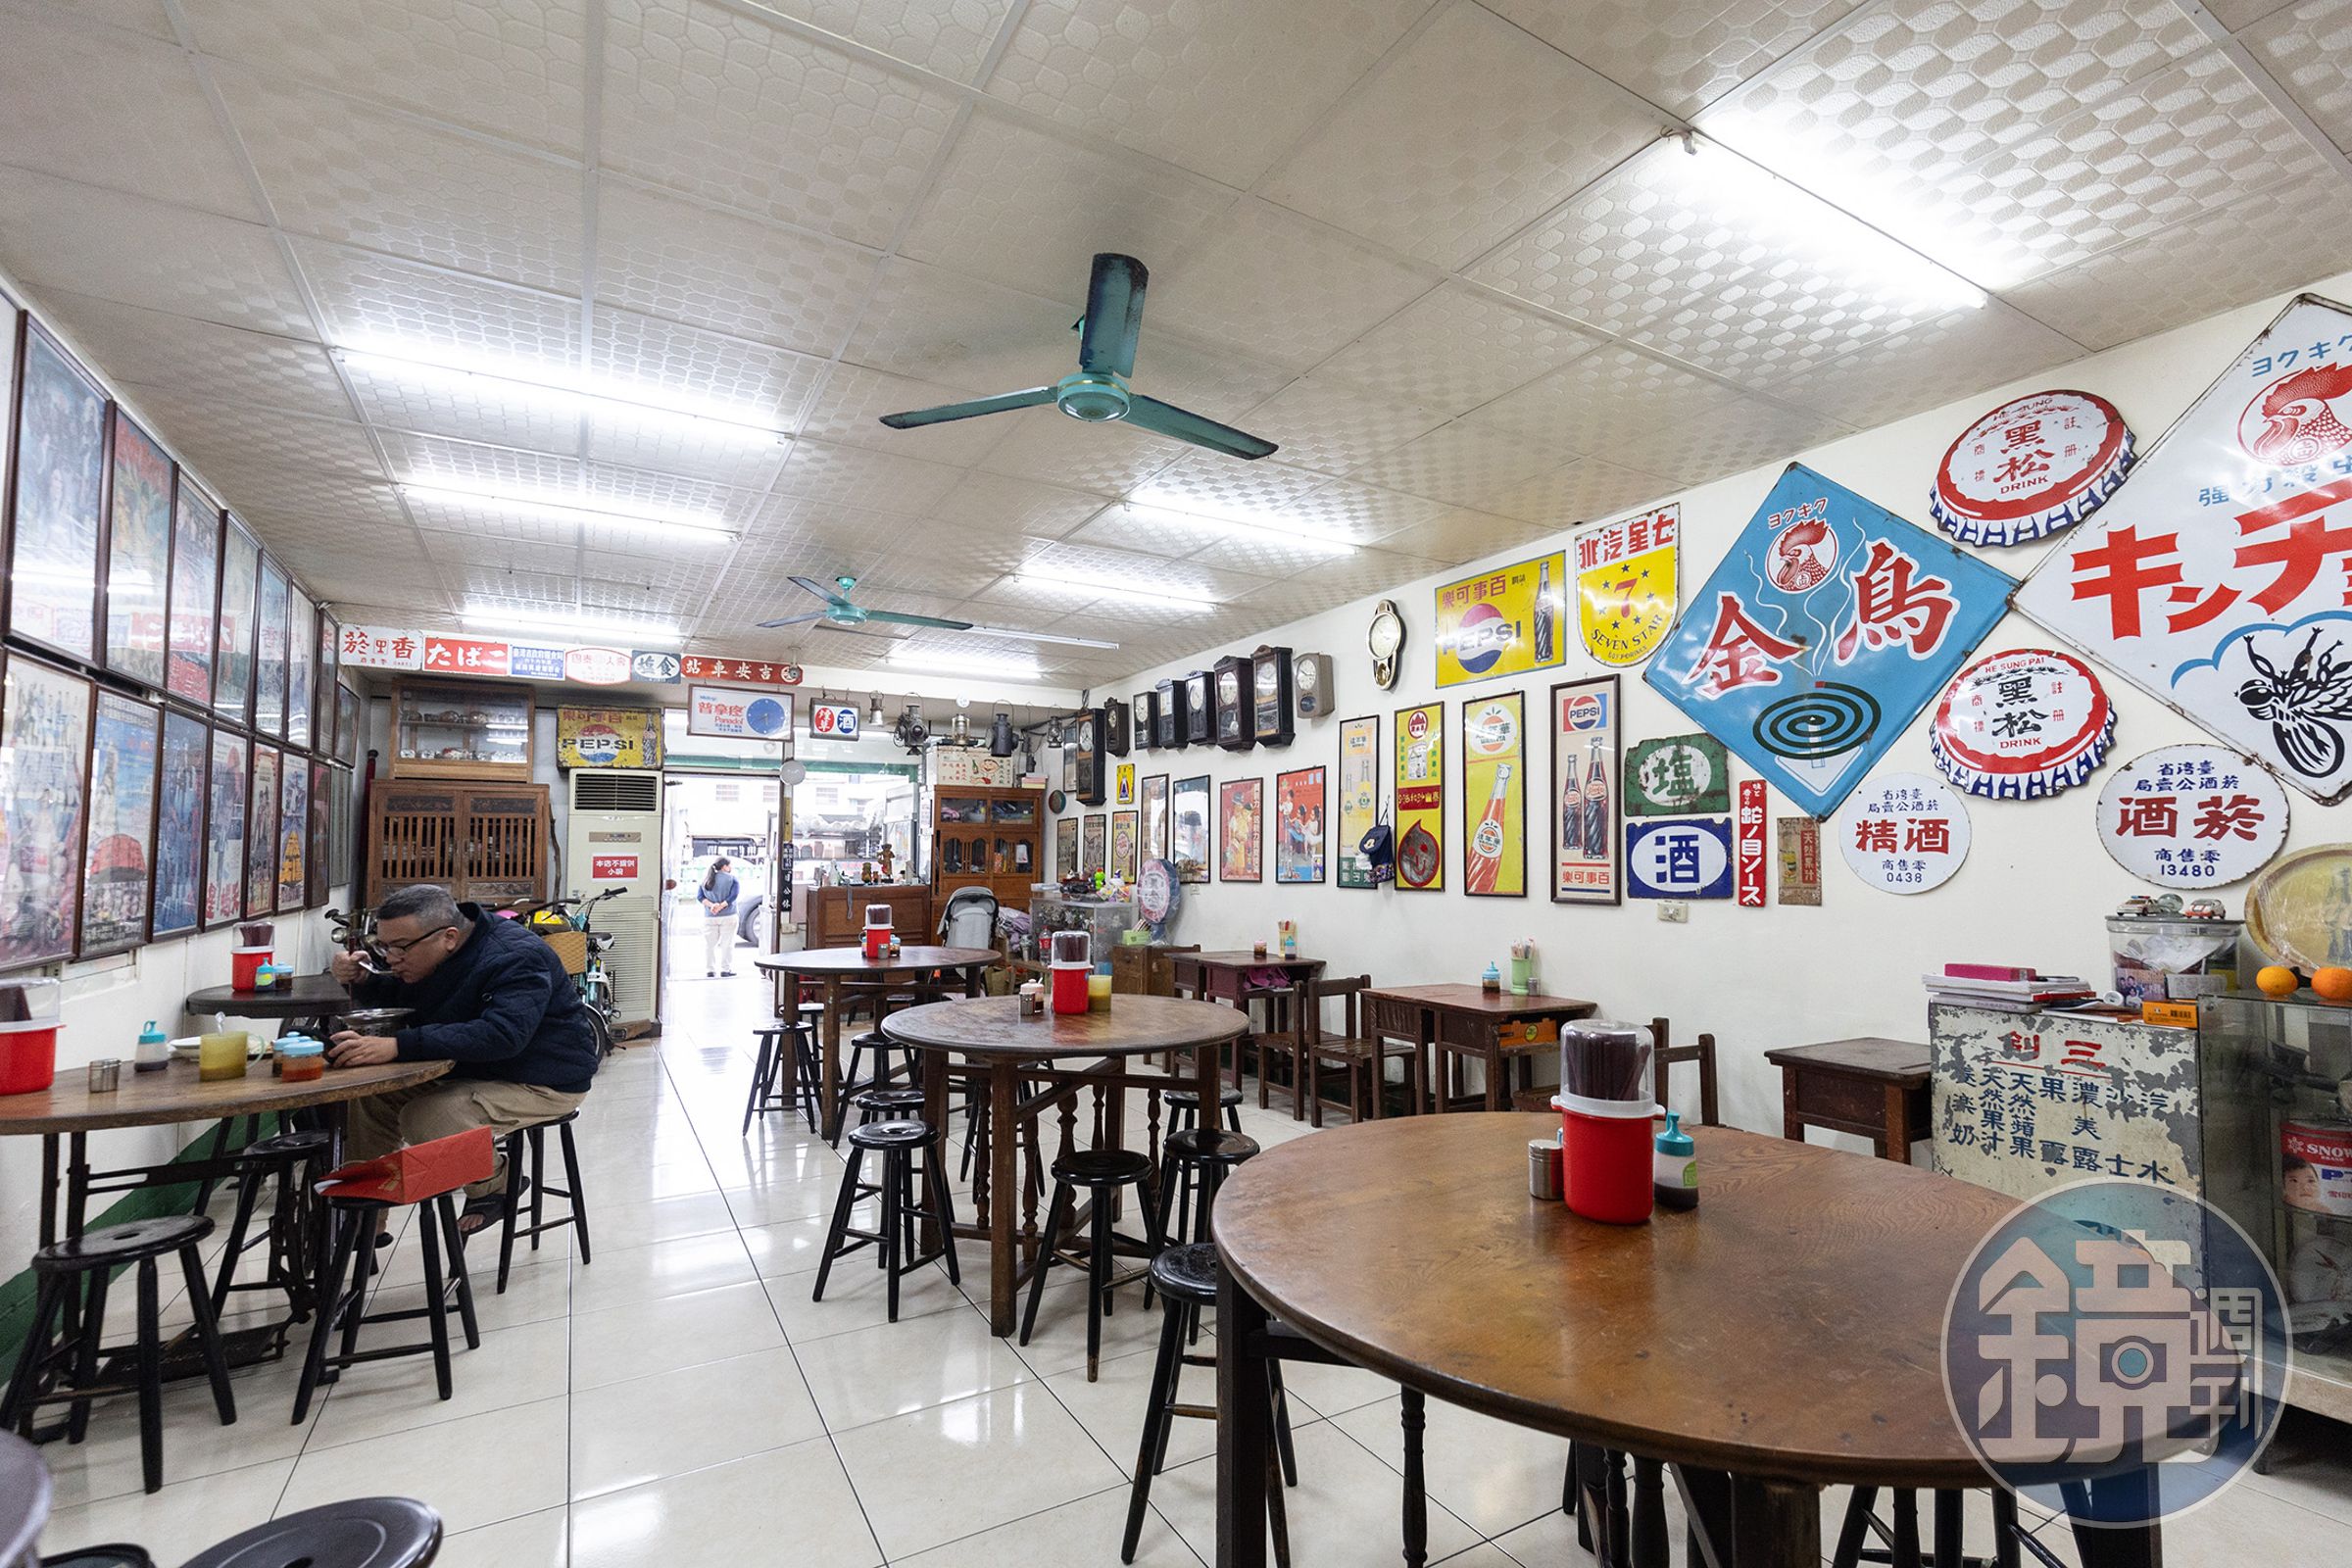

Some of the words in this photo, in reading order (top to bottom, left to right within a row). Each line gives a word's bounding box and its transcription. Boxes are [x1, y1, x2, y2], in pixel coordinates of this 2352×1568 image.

[2000, 476, 2048, 494] DRINK
[1767, 497, 1828, 530] ヨクキク
[2071, 476, 2352, 641] キンチ
[1614, 578, 1638, 618] 7
[1686, 541, 1954, 696] 金鳥
[1592, 628, 1628, 651] SEVEN
[1632, 614, 1663, 646] STAR
[426, 643, 508, 667] たばこ
[1984, 664, 2000, 674] HE
[2001, 661, 2027, 671] SUNG
[2028, 658, 2045, 666] PAI
[714, 715, 744, 725] Panadol
[838, 714, 855, 730] 酒
[1569, 707, 1600, 718] PEPSI
[563, 738, 634, 750] PEPSI
[1999, 737, 2041, 750] DRINK
[1651, 751, 1699, 797] 塩
[1655, 834, 1700, 883] 酒
[1740, 806, 1763, 905] 蛇ノ目ソース
[1562, 870, 1609, 885] 百事可樂
[1886, 871, 1923, 883] 0438
[2160, 864, 2215, 877] 13480
[2008, 1071, 2036, 1159] 天然蘋果
